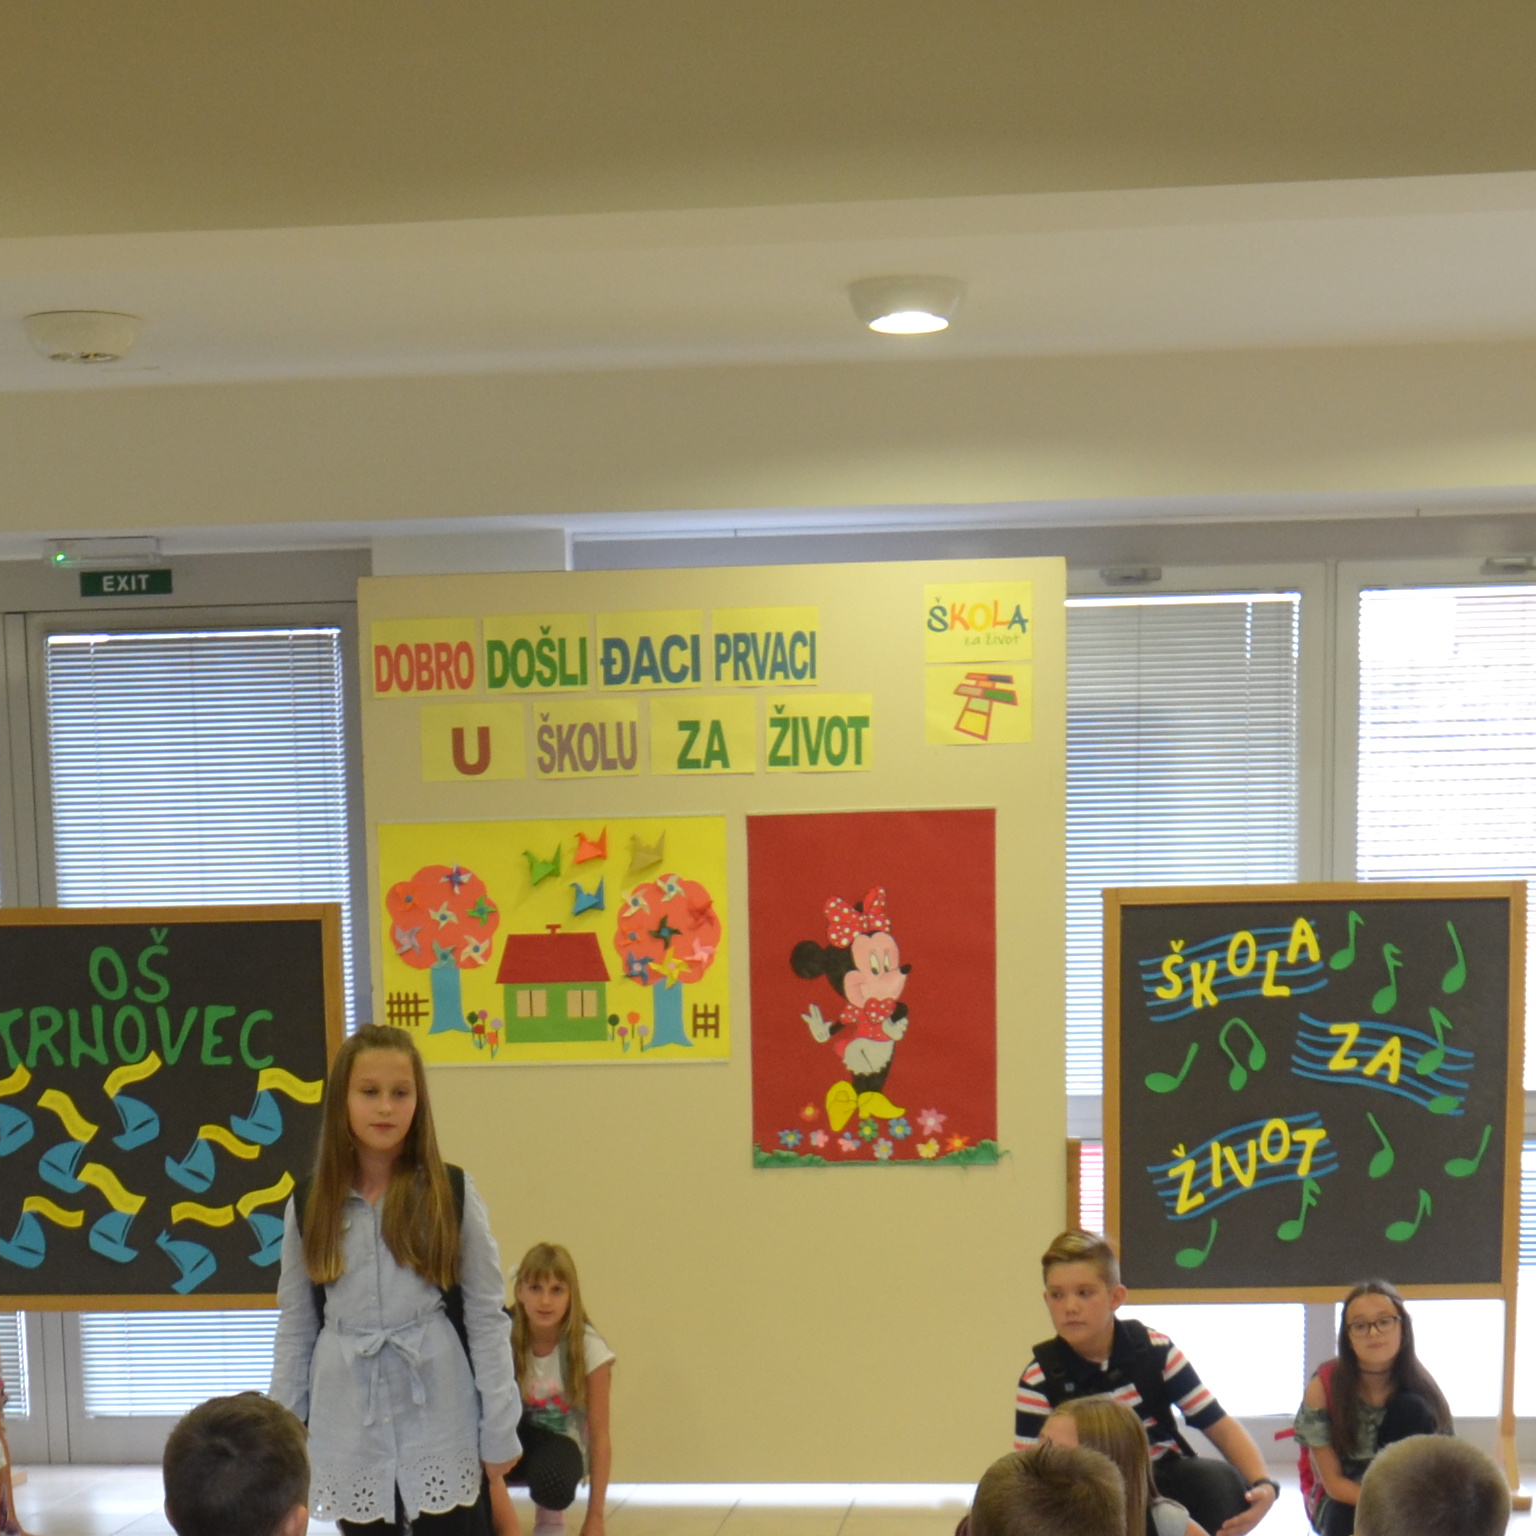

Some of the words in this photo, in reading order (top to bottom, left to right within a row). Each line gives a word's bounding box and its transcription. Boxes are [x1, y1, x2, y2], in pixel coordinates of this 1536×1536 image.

[102, 574, 149, 592] EXIT
[927, 596, 1029, 634] ŠKOLA
[374, 640, 475, 692] DOBRO
[486, 625, 589, 688] DOŠLI
[600, 634, 701, 686] ĐACI
[714, 630, 816, 682] PRVACI
[451, 726, 491, 776] U
[537, 712, 638, 774] ŠKOLU
[677, 720, 731, 770] ZA
[767, 704, 870, 767] ŽIVOT
[89, 927, 170, 1003] OŠ
[1155, 917, 1321, 1009] ŠKOLA
[1328, 1022, 1402, 1084] ZA
[1168, 1118, 1327, 1215] ŽIVOT
